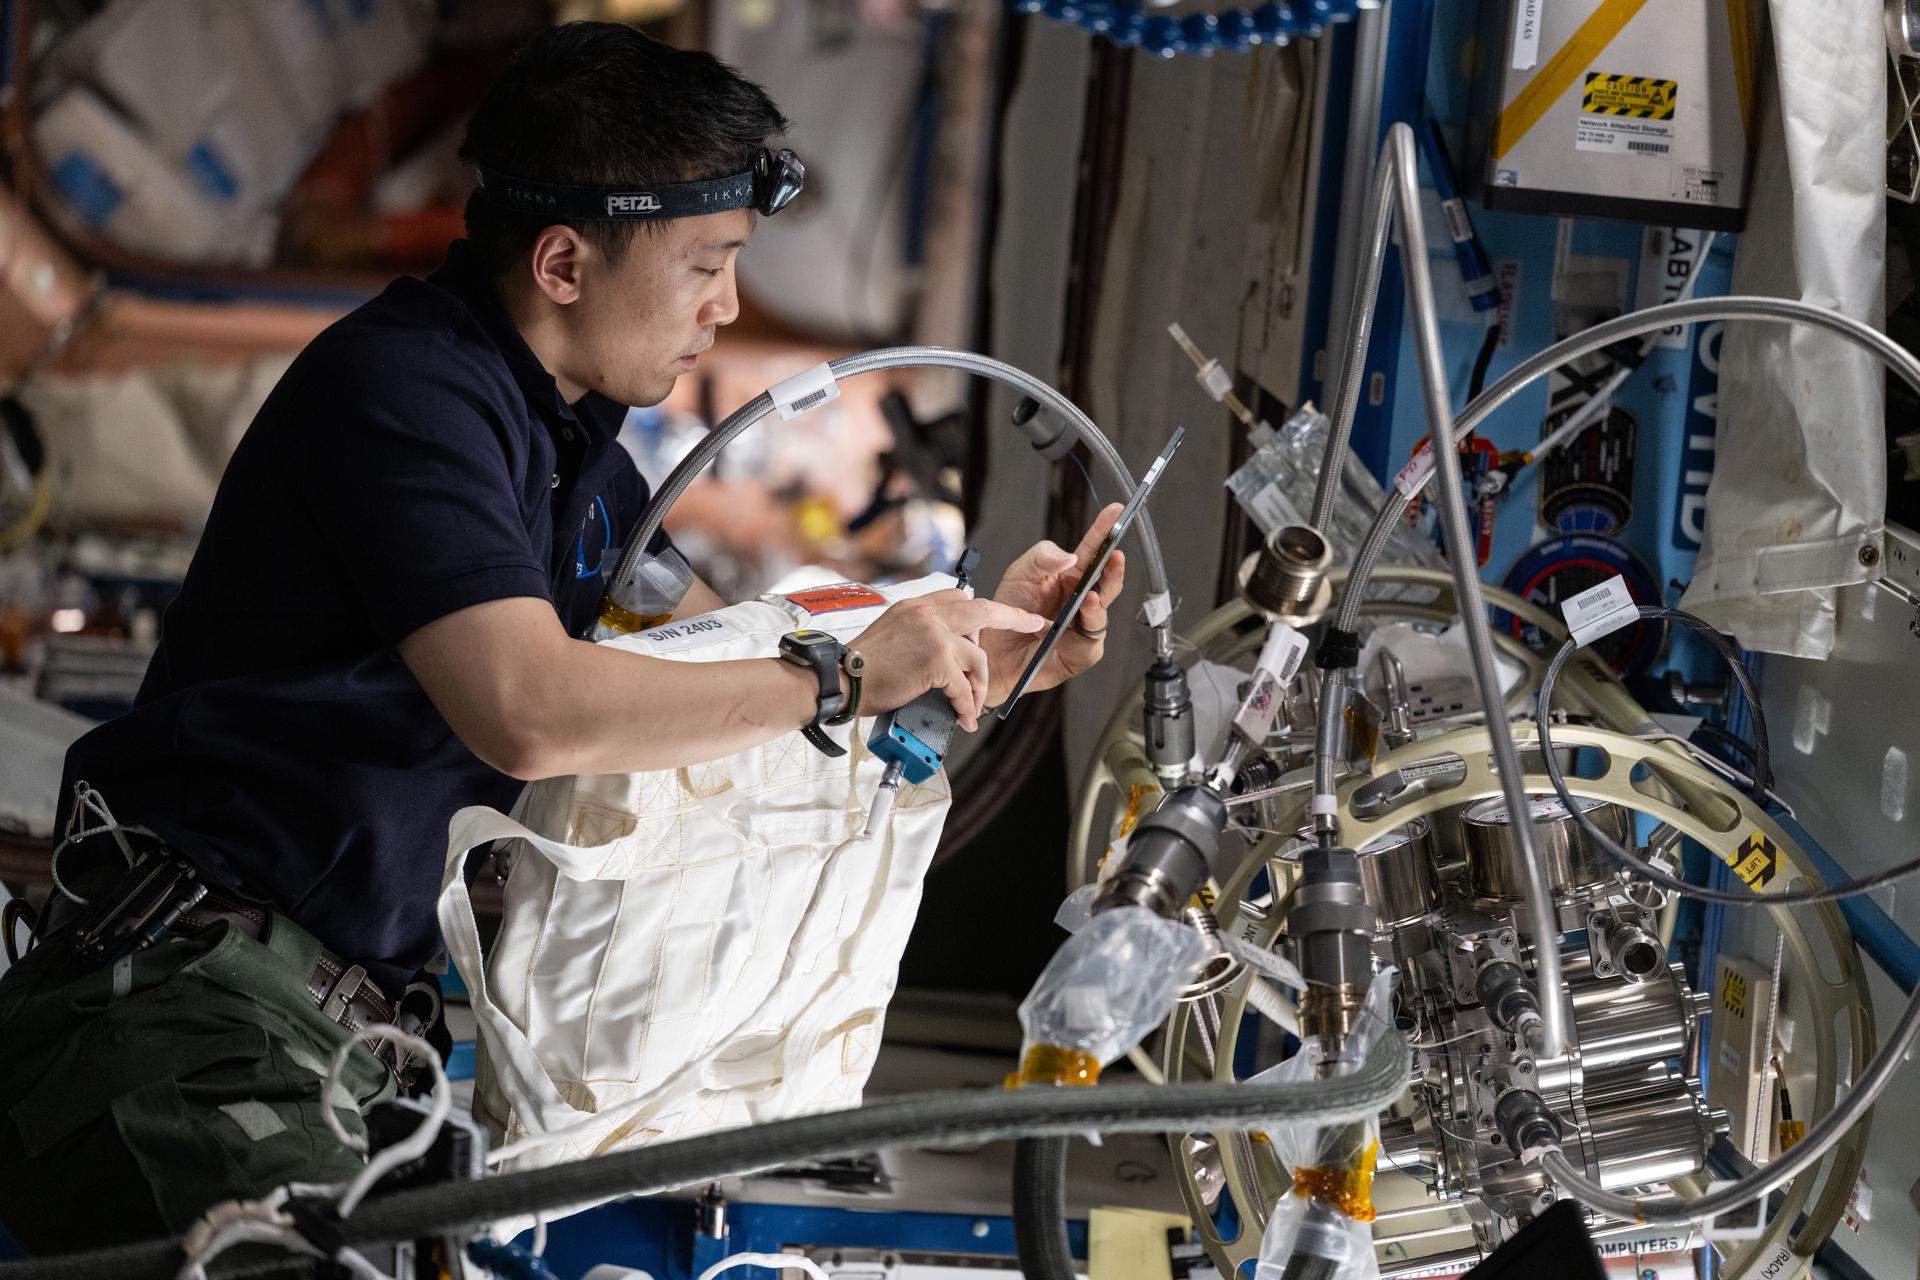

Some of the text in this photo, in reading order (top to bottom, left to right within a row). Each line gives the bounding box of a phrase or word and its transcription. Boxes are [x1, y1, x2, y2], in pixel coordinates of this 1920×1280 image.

[1523, 19, 1534, 41] NAS
[1605, 82, 1649, 95] CAUTION
[1579, 119, 1668, 135] Network Attached Storage
[506, 188, 556, 205] TIKKA
[702, 184, 754, 203] TIKKA
[606, 194, 662, 216] PETZL
[647, 619, 722, 642] S/N 2403
[1745, 857, 1762, 875] LIFT
[1596, 1234, 1679, 1258] OMPUTERS
[1761, 1248, 1791, 1280] (RACK)
